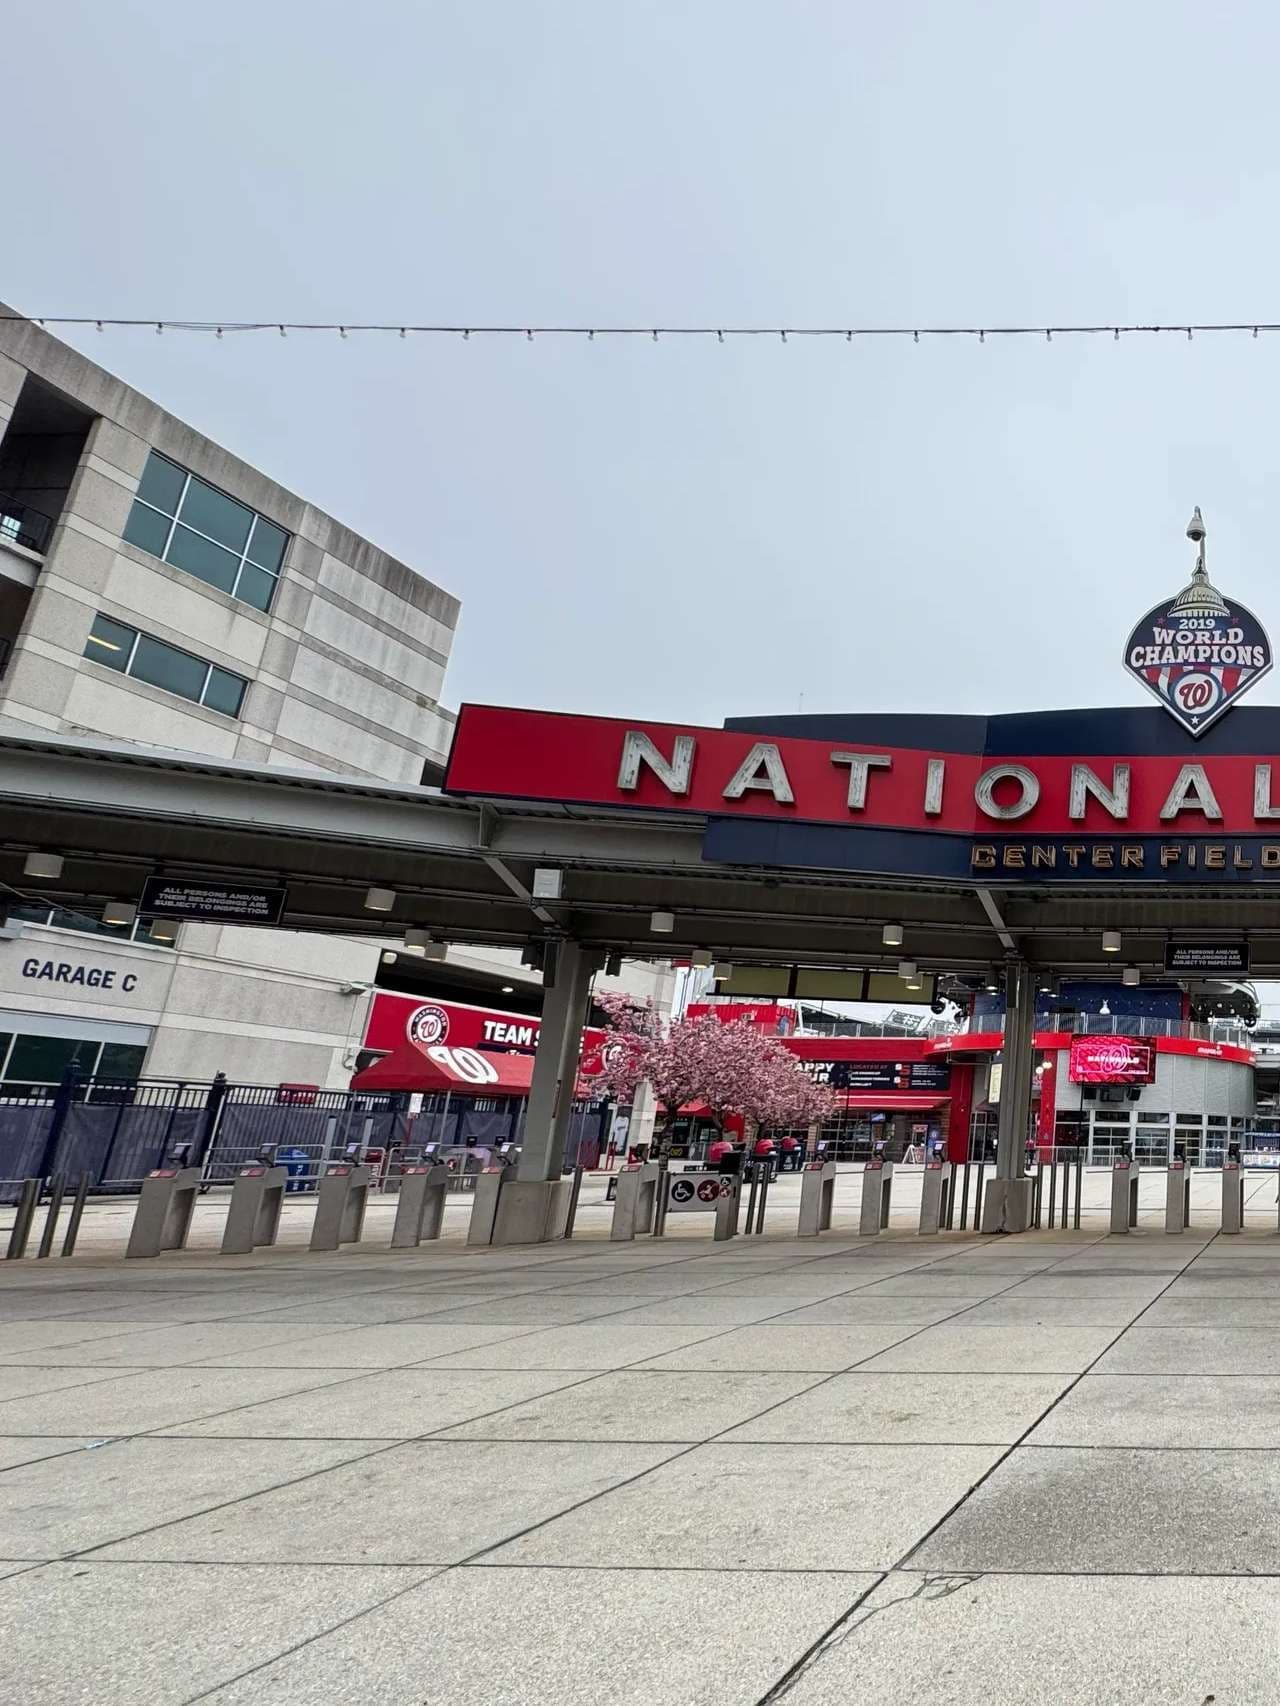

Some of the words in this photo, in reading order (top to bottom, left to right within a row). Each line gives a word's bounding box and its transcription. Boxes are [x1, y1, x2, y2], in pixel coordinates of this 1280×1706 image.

[1179, 618, 1216, 630] 2019
[1152, 626, 1244, 645] WORLD
[1130, 645, 1265, 668] CHAMPIONS
[1179, 679, 1213, 711] W
[970, 844, 1145, 869] CENTER
[158, 893, 188, 902] THEIR
[188, 895, 248, 907] BELONGINGS
[248, 901, 269, 909] ARE
[183, 888, 228, 899] PERSONS
[229, 893, 267, 902] AND/OR
[153, 899, 196, 909] SUBJECT
[212, 904, 269, 915] INSPECTION
[22, 958, 117, 990] GARAGE
[121, 973, 138, 993] C
[483, 1020, 532, 1046] TEAM
[794, 1062, 835, 1073] APPY
